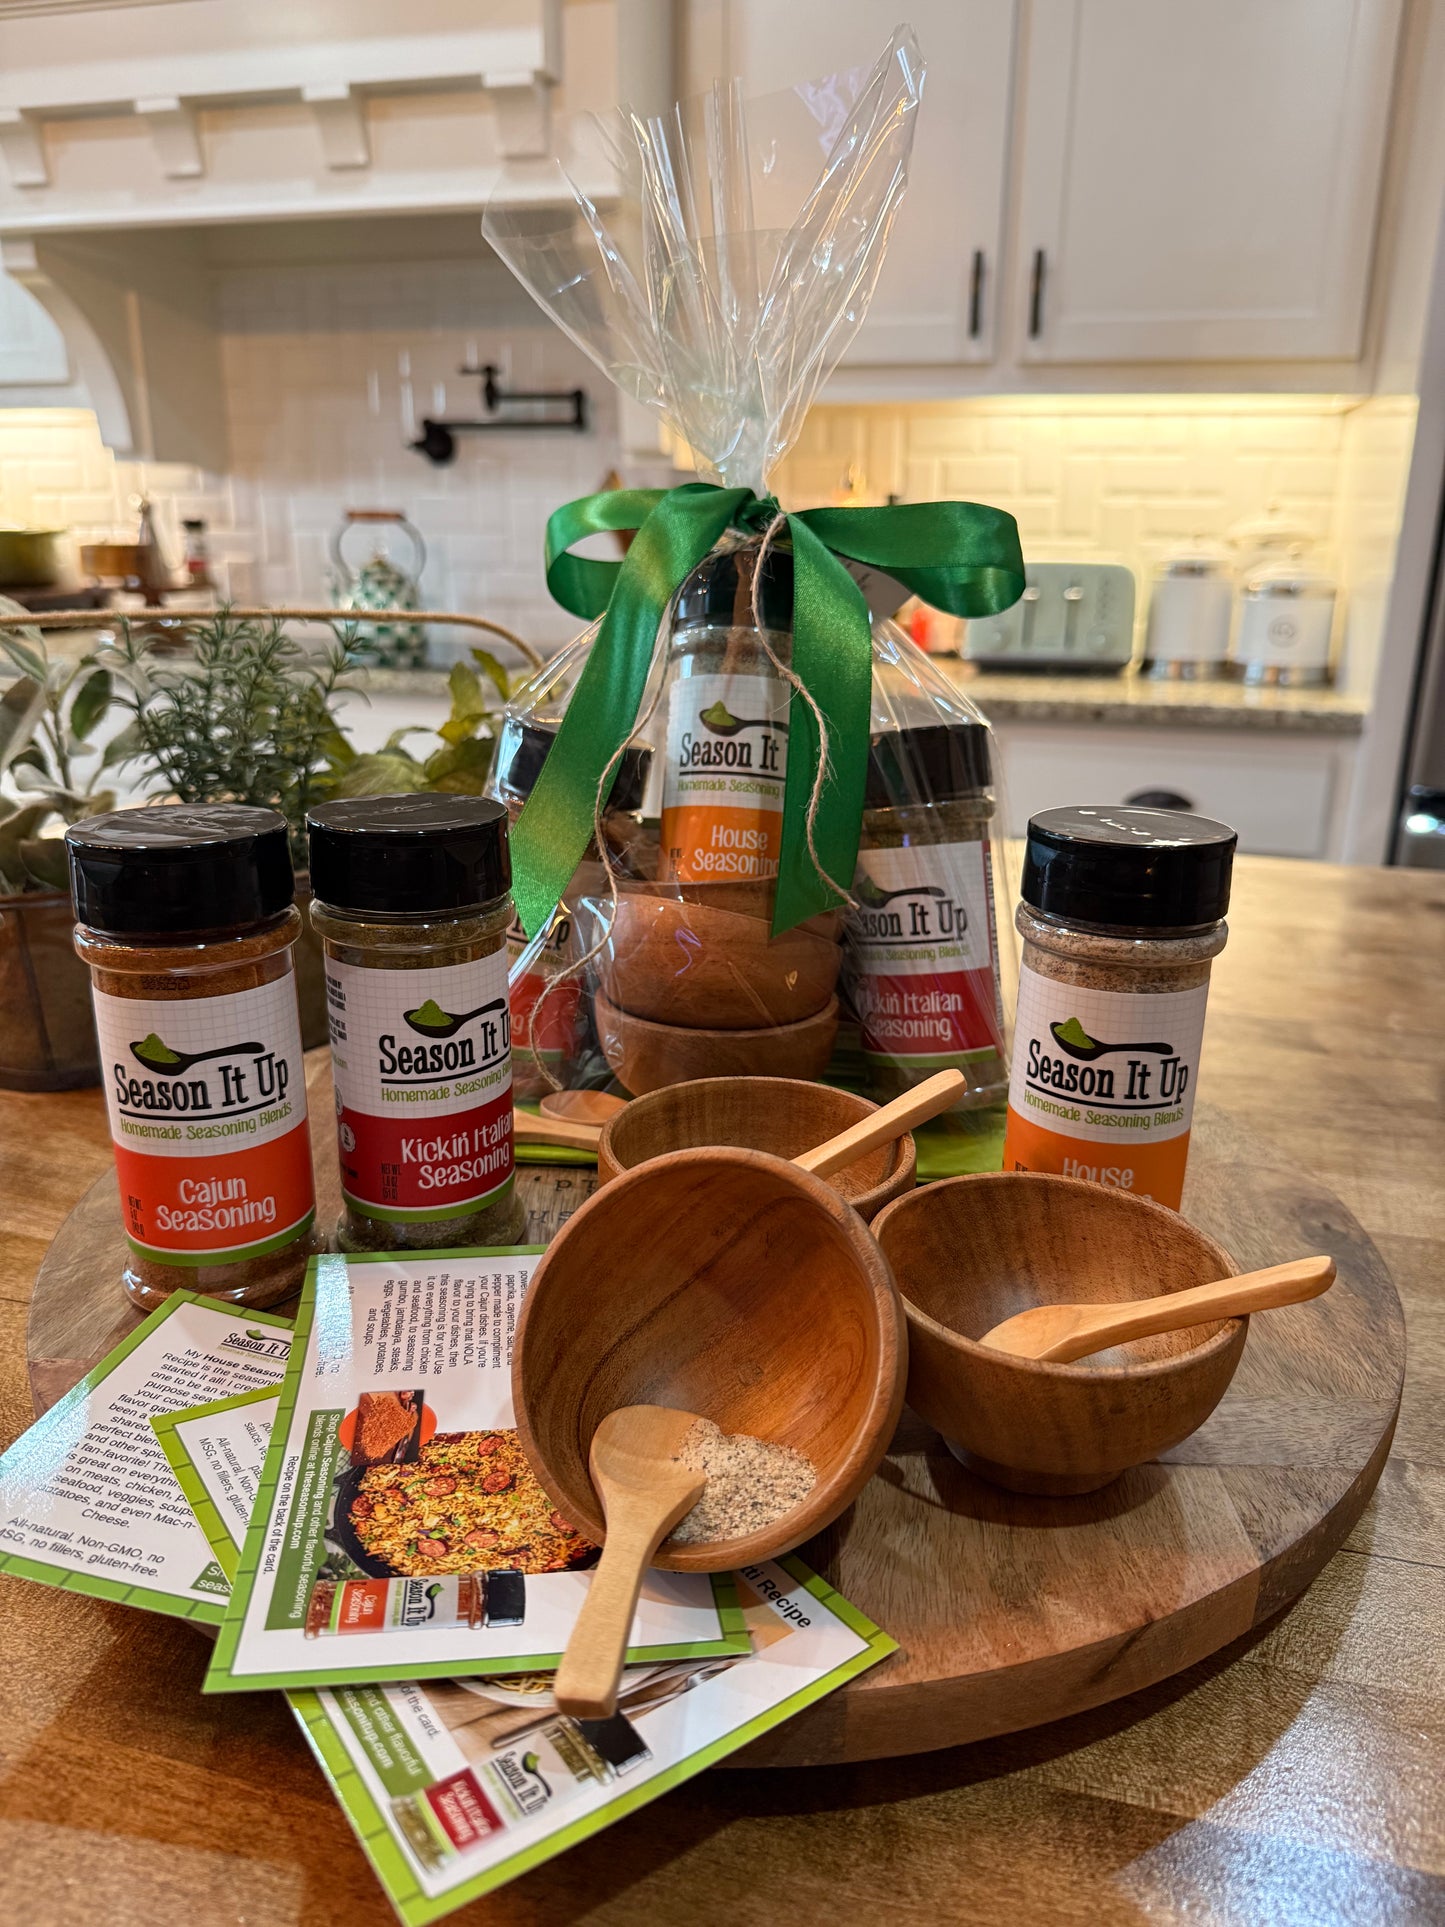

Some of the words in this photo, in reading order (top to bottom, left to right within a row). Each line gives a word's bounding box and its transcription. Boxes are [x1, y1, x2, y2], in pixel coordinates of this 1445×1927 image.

[679, 733, 752, 768] Season
[759, 735, 779, 772] It
[677, 779, 727, 792] Homemade
[729, 779, 780, 797] Seasoning
[711, 825, 768, 850] House
[908, 902, 930, 936] It
[936, 900, 968, 940] Up
[904, 991, 963, 1014] Italian
[379, 1034, 475, 1075] Season
[481, 1020, 498, 1061] It
[114, 1063, 212, 1111] Season
[218, 1064, 250, 1107] It
[253, 1052, 289, 1101] Up
[1026, 1038, 1115, 1098] Season
[1124, 1060, 1151, 1100] It
[1160, 1056, 1188, 1105] Up
[381, 1086, 450, 1102] Homemade
[454, 1068, 501, 1098] Seasoning
[120, 1118, 182, 1140] Homemade
[186, 1118, 256, 1140] Seasoning
[259, 1101, 292, 1127] Blends
[1024, 1089, 1080, 1122] Homemade
[1084, 1110, 1150, 1130] Seasoning
[1153, 1107, 1184, 1127] Blends
[474, 1111, 513, 1153] Italian
[418, 1141, 510, 1190] Seasoning
[1063, 1157, 1134, 1189] House
[179, 1176, 247, 1208] Cajun
[156, 1195, 276, 1232] Seasoning
[383, 1279, 395, 1299] eggs,
[412, 1280, 422, 1293] and
[427, 1281, 436, 1290] on
[440, 1273, 450, 1286] this
[465, 1280, 476, 1299] trying
[479, 1275, 488, 1292] your
[492, 1273, 502, 1297] pepper
[397, 1280, 409, 1306] gumbo,
[452, 1299, 461, 1307] to
[466, 1300, 475, 1308] to
[478, 1292, 489, 1312] Cajun
[367, 1307, 378, 1322] and
[408, 1294, 421, 1325] seafood,
[421, 1291, 434, 1328] everything
[435, 1288, 449, 1323] seasoning
[450, 1308, 460, 1323] your
[463, 1308, 476, 1326] bring
[493, 1298, 503, 1318] made
[378, 1299, 392, 1341] vegetables,
[392, 1306, 407, 1346] jambalaya,
[408, 1325, 418, 1334] to
[437, 1323, 447, 1331] is
[493, 1319, 502, 1327] to
[223, 1332, 265, 1351] Season
[265, 1343, 279, 1355] It
[363, 1322, 375, 1346] soups.
[422, 1328, 433, 1346] from
[436, 1331, 447, 1341] for
[449, 1324, 461, 1350] dishes,
[465, 1327, 475, 1342] that
[185, 1348, 203, 1359] My
[203, 1354, 240, 1368] House
[373, 1341, 387, 1375] potatoes,
[388, 1346, 401, 1373] steaks,
[402, 1334, 416, 1372] seasoning
[419, 1346, 431, 1375] chicken
[433, 1342, 445, 1358] you!
[449, 1351, 460, 1368] then
[464, 1343, 475, 1365] NOLA
[476, 1344, 486, 1368] you're
[161, 1363, 200, 1379] started
[200, 1373, 207, 1381] it
[227, 1379, 233, 1387] I
[162, 1352, 200, 1368] Recipe
[201, 1363, 210, 1371] is
[212, 1366, 231, 1377] the
[433, 1359, 444, 1375] Use
[144, 1380, 190, 1397] purpose
[151, 1371, 172, 1381] one
[174, 1377, 185, 1385] to
[187, 1380, 202, 1390] be
[203, 1385, 218, 1394] an
[118, 1393, 151, 1408] flavor
[134, 1389, 163, 1400] your
[108, 1402, 138, 1416] been
[91, 1422, 134, 1439] perfect
[110, 1415, 151, 1431] shared
[244, 1421, 263, 1446] sauce,
[312, 1414, 326, 1439] blends
[327, 1413, 340, 1433] Shop
[84, 1432, 110, 1444] and
[109, 1440, 141, 1452] other
[308, 1439, 320, 1461] online
[323, 1433, 336, 1456] Cajun
[66, 1451, 77, 1460] is
[77, 1456, 111, 1470] great
[111, 1465, 127, 1474] on
[81, 1442, 150, 1468] fan-favorite!
[199, 1437, 217, 1460] MSG,
[210, 1459, 222, 1470] no
[216, 1470, 234, 1494] fillers,
[216, 1437, 246, 1476] All-natural,
[306, 1461, 315, 1470] at
[284, 1455, 300, 1482] Recipe
[313, 1456, 333, 1500] Seasoning
[53, 1475, 103, 1495] seafood,
[107, 1489, 155, 1508] veggies,
[65, 1465, 81, 1474] on
[82, 1470, 121, 1487] meats,
[125, 1481, 172, 1500] chicken,
[282, 1482, 292, 1493] on
[278, 1493, 291, 1507] the
[290, 1470, 315, 1549] theseasonitup.com
[312, 1500, 323, 1515] and
[82, 1508, 130, 1528] Cheese.
[95, 1500, 121, 1511] and
[120, 1506, 151, 1519] even
[153, 1513, 197, 1529] Mac-n-
[273, 1507, 288, 1527] back
[271, 1528, 283, 1537] of
[308, 1516, 320, 1537] other
[7, 1516, 74, 1543] All-natural,
[77, 1536, 142, 1560] Non-GMO,
[147, 1553, 165, 1564] no
[268, 1537, 281, 1552] the
[29, 1538, 48, 1548] no
[48, 1542, 84, 1560] fillers,
[87, 1552, 159, 1577] gluten-free.
[263, 1553, 276, 1575] card.
[301, 1538, 318, 1572] flavorful
[289, 1573, 310, 1618] seasoning
[408, 1578, 429, 1604] Season
[344, 1588, 366, 1624] Seasoning
[407, 1606, 427, 1615] It
[756, 1578, 812, 1628] Recipe
[400, 1684, 417, 1696] of
[407, 1694, 424, 1713] the
[361, 1688, 383, 1707] and
[374, 1706, 397, 1733] other
[389, 1732, 424, 1777] flavorful
[417, 1713, 441, 1740] card.
[495, 1750, 528, 1790] Season
